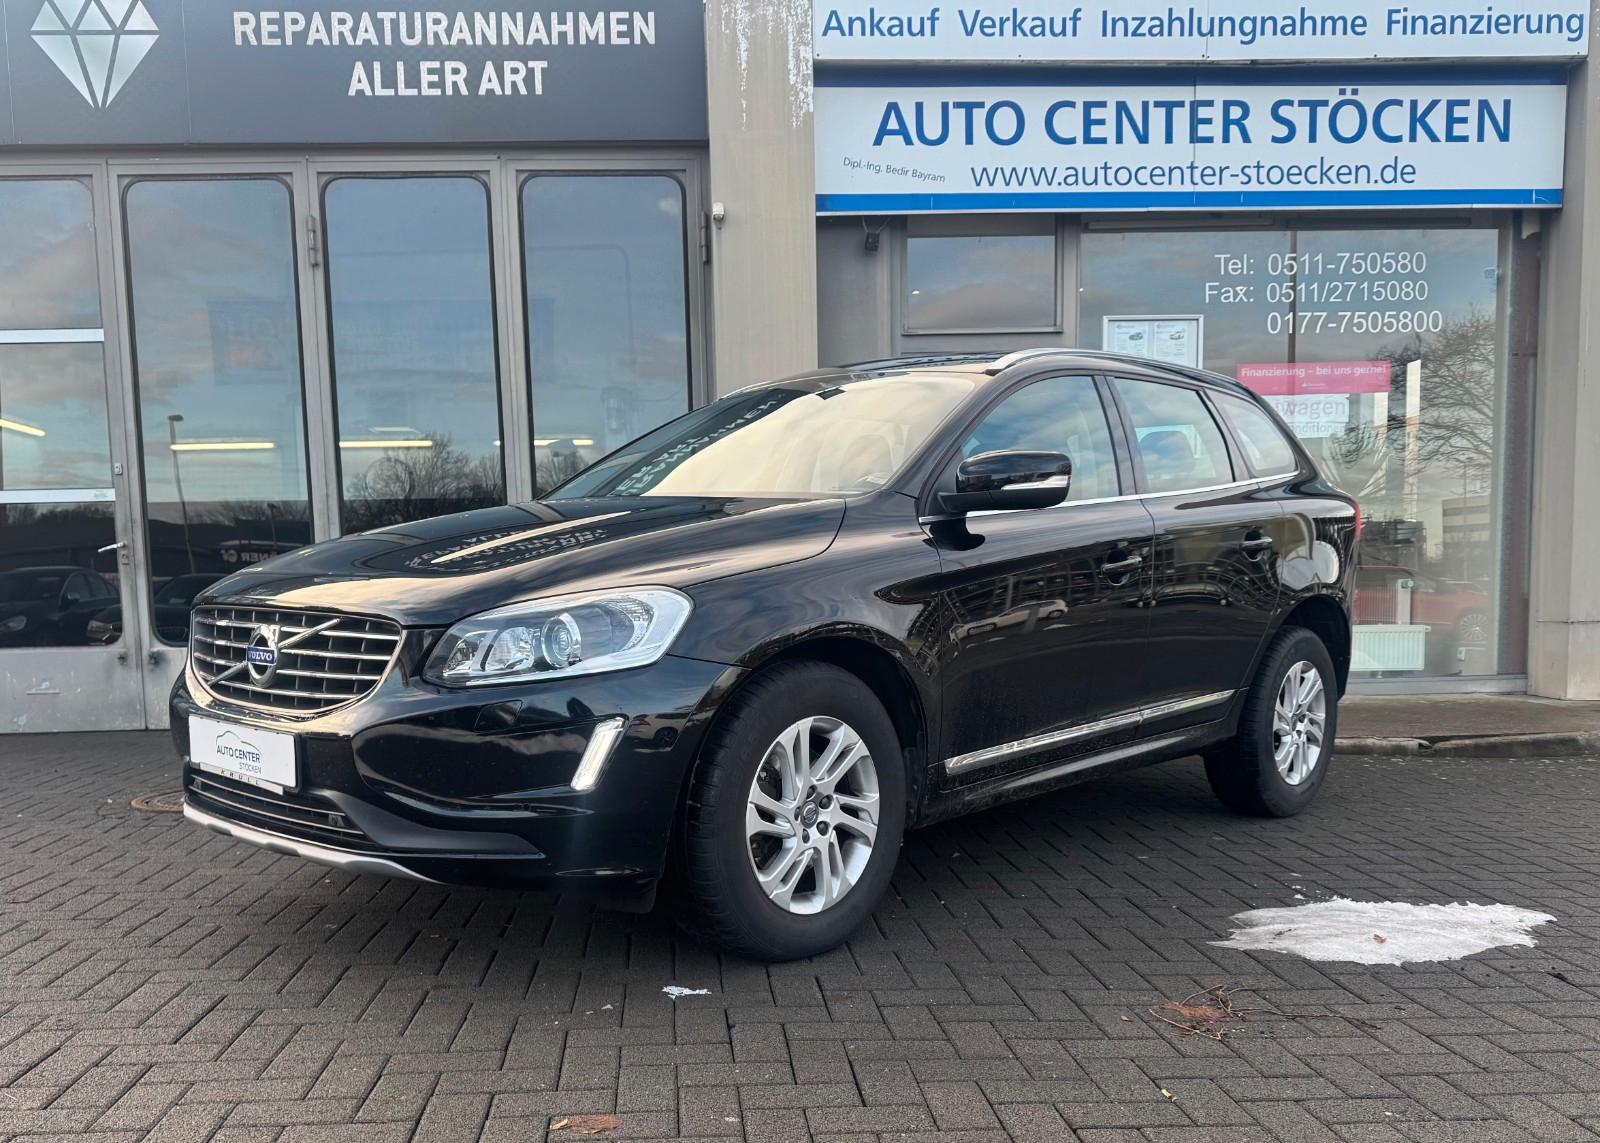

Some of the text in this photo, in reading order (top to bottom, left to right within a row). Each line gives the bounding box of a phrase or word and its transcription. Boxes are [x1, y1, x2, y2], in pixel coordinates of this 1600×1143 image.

[233, 11, 656, 46] REPARATURANNAHMEN
[821, 6, 1584, 45] Ankauf Verkauf Inzahlungnahme Finanzierung
[347, 60, 548, 97] ALLER ART
[872, 87, 1512, 147] AUTO CENTER STÖCKEN
[843, 156, 946, 183] Dipl.-Ing. Bedir Bayram
[970, 156, 1417, 188] www.autocenter-stoecken.de
[1214, 251, 1427, 276] Tel: 0511-750580
[1205, 280, 1429, 304] Fax: 0511/2715080
[1267, 310, 1443, 335] 0177-7505800
[1241, 367, 1305, 377] Finanzierung
[1316, 366, 1331, 375] bei
[1334, 366, 1352, 374] uns
[248, 650, 273, 661] VOLVO
[216, 744, 261, 763] AUTO CENTER
